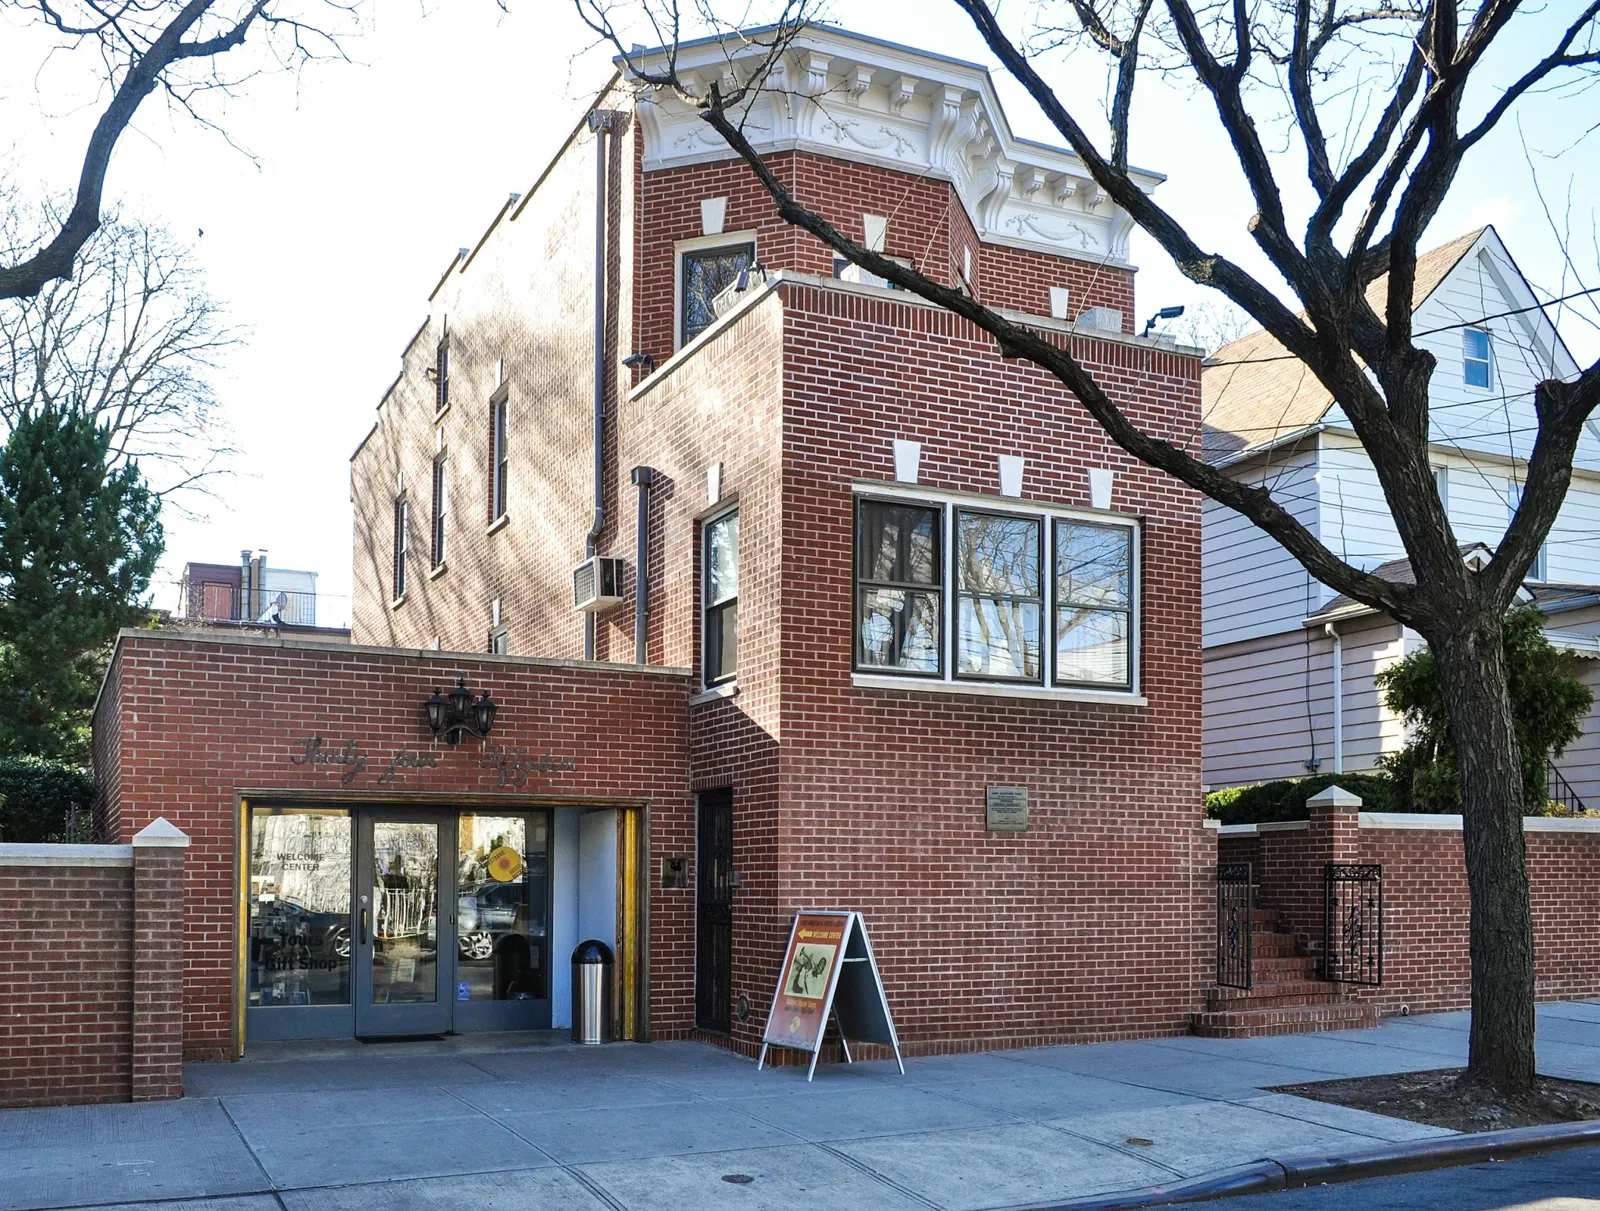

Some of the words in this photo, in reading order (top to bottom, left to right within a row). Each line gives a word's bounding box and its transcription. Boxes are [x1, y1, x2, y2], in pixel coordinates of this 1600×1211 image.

[277, 853, 325, 861] WELCOME
[282, 863, 320, 871] CENTER
[281, 934, 323, 946] Tours
[264, 957, 294, 970] Gift
[298, 957, 337, 972] Shop
